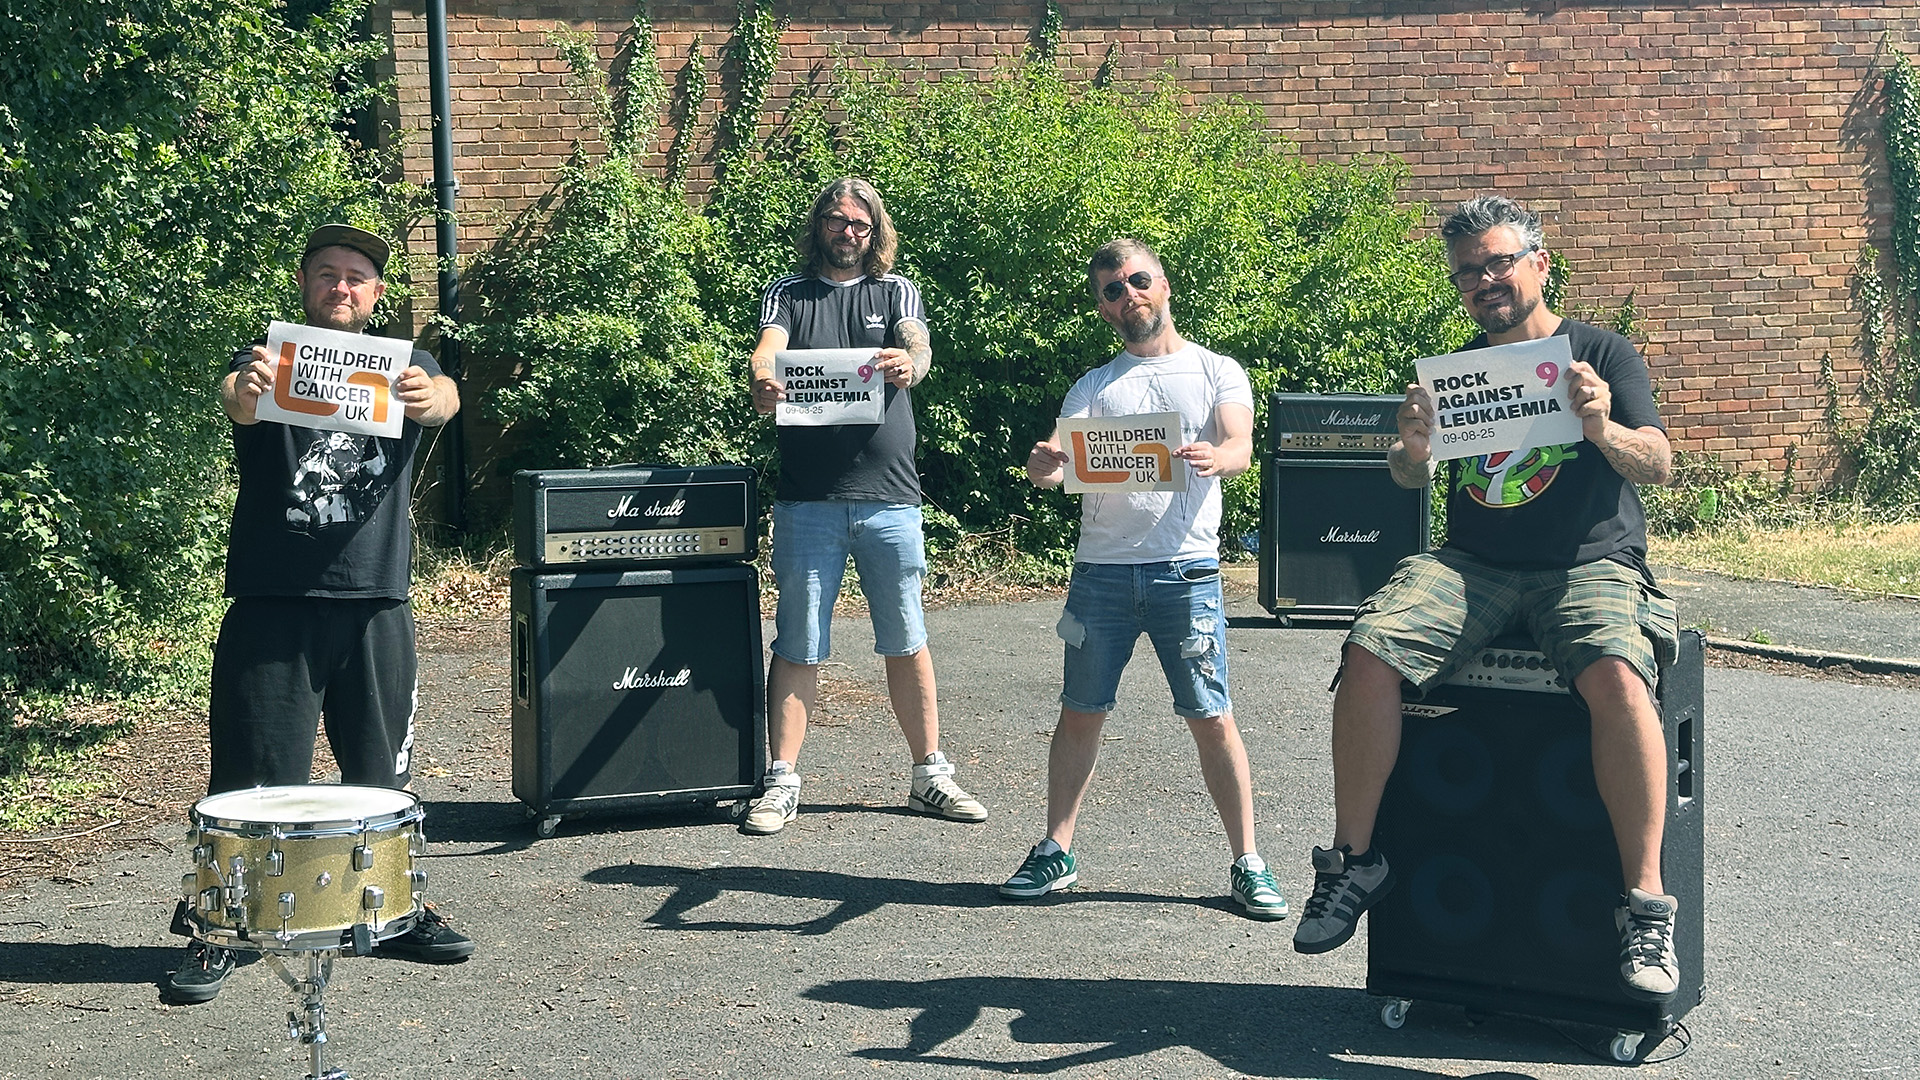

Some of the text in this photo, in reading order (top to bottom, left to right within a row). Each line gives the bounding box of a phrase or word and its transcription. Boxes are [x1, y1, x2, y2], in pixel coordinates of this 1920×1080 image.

[300, 345, 392, 371] CHILDREN
[297, 362, 343, 383] WITH
[785, 366, 825, 377] ROCK
[857, 364, 874, 384] 9
[1535, 361, 1559, 388] 9
[785, 378, 848, 390] AGAINST
[1432, 371, 1490, 393] ROCK
[294, 380, 370, 403] CANCER
[786, 391, 871, 403] LEUKAEMIA
[1438, 384, 1525, 411] AGAINST
[345, 404, 369, 422] UK
[1321, 410, 1380, 427] Marshall
[1440, 398, 1562, 429] LEUKAEMIA
[1087, 428, 1166, 442] CHILDREN
[1442, 428, 1495, 444] 09-08-25
[1089, 443, 1127, 455] WITH
[1090, 456, 1155, 469] CANCER
[1136, 471, 1156, 483] UK
[1320, 526, 1380, 543] Marshall
[613, 666, 691, 691] Marshall
